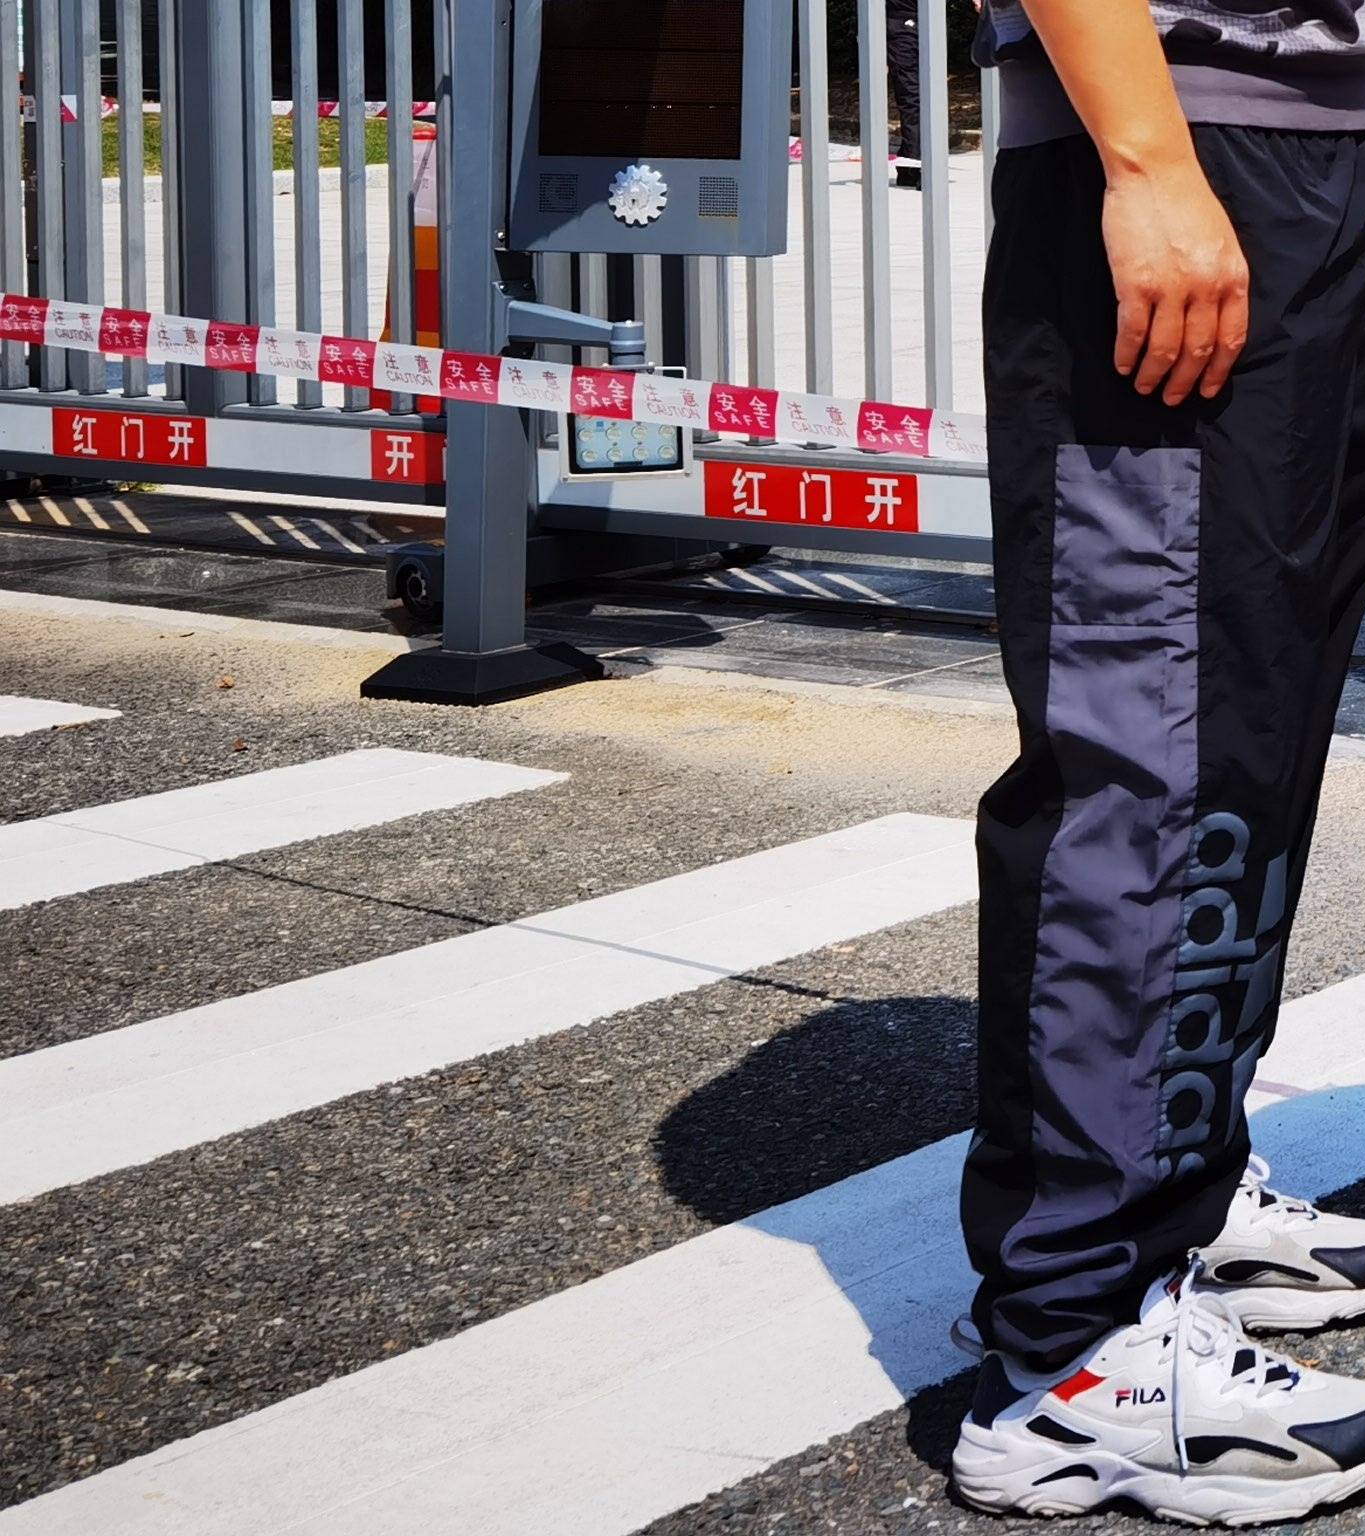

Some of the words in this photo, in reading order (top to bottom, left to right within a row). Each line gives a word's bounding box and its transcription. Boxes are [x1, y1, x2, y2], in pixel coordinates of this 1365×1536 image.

[6, 303, 42, 322] 安全
[105, 315, 144, 338] 安全
[212, 328, 253, 352] 安全
[324, 343, 369, 368] 安全
[446, 359, 494, 383] 安全
[576, 375, 628, 400] 安全
[716, 392, 771, 418] 安全
[865, 410, 924, 437] 安全
[103, 332, 143, 352] SAFE
[209, 347, 252, 364] SAFE
[324, 361, 370, 379] SAFE
[446, 377, 495, 396] SAFE
[574, 393, 629, 413] SAFE
[715, 411, 770, 430] SAFE
[863, 429, 924, 449] SAFE
[72, 414, 194, 461] 红门开
[385, 435, 414, 477] 开
[732, 467, 902, 525] 红门开
[1115, 1387, 1166, 1408] FILA
